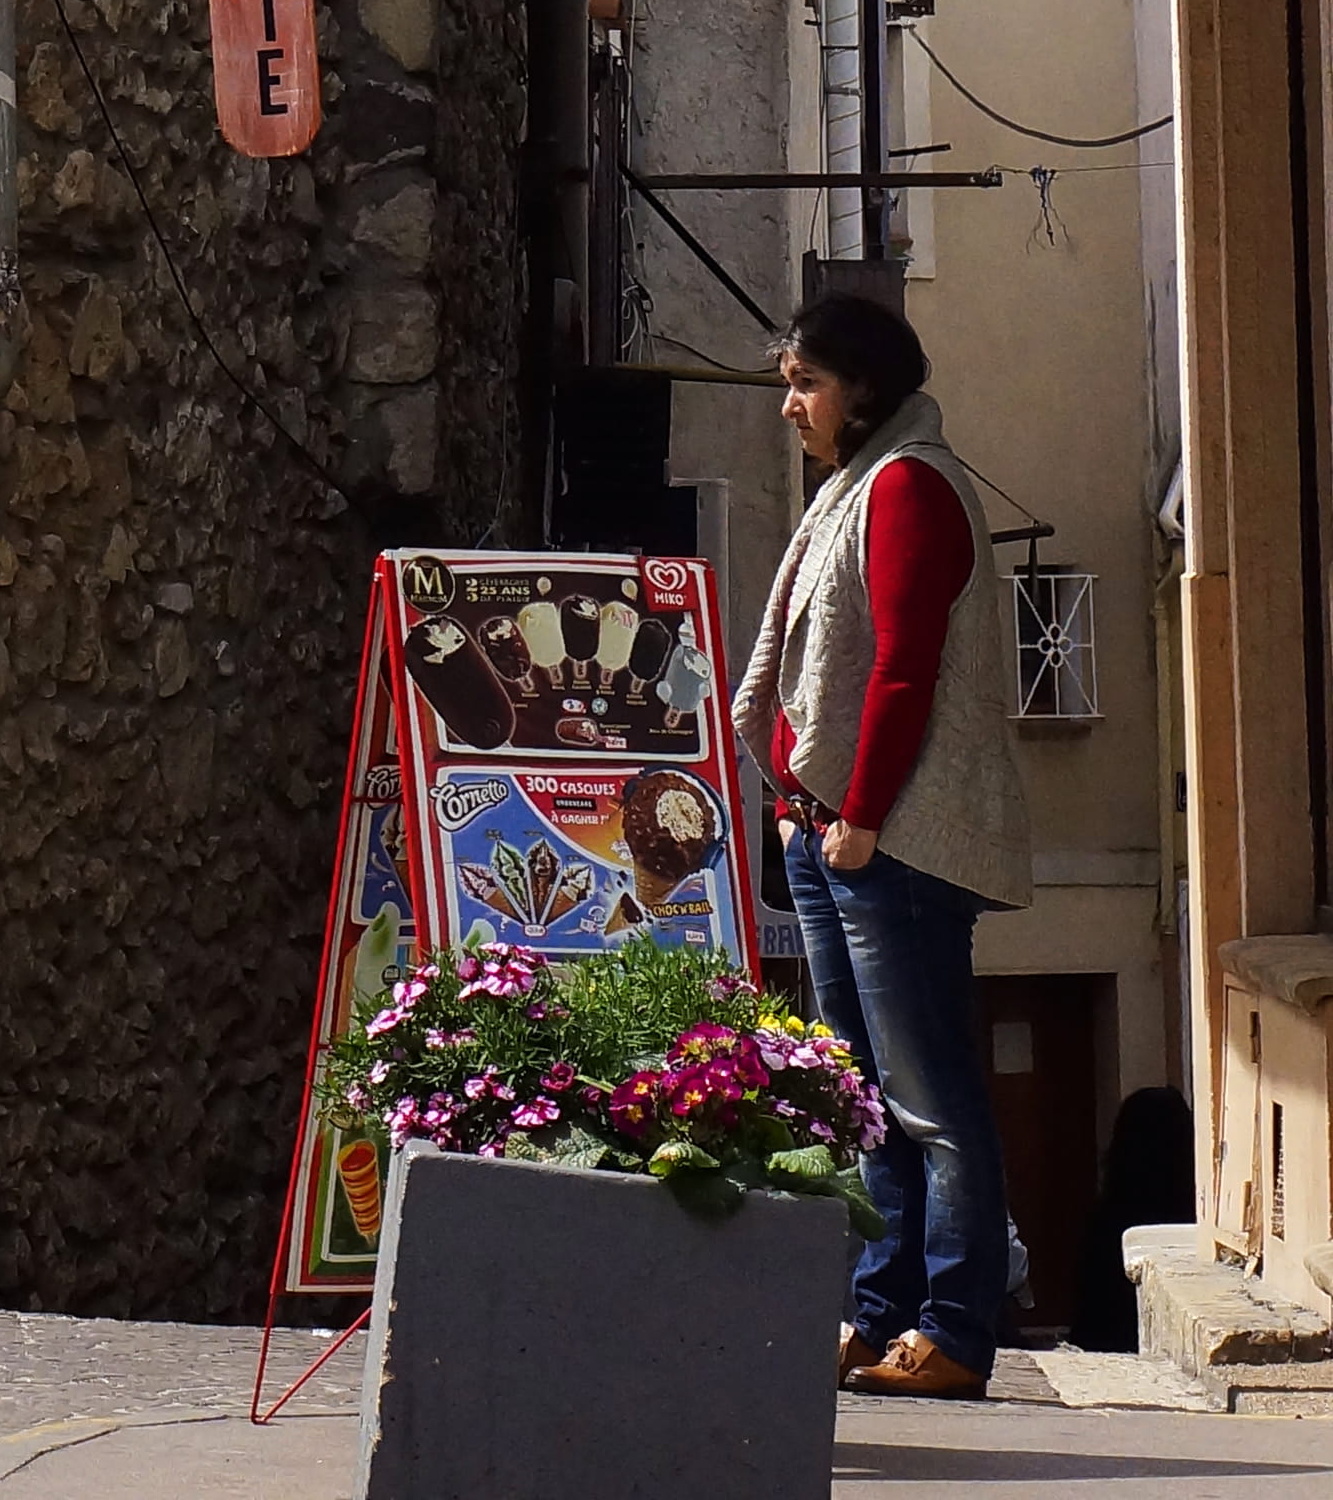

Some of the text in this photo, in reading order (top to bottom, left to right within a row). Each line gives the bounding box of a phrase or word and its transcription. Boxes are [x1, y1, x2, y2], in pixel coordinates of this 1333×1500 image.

[479, 586, 531, 596] 25 ANS
[654, 591, 685, 606] MIKO
[525, 776, 616, 796] 300 CASQUES
[430, 778, 508, 831] Cornetto
[560, 814, 599, 825] GAGNER
